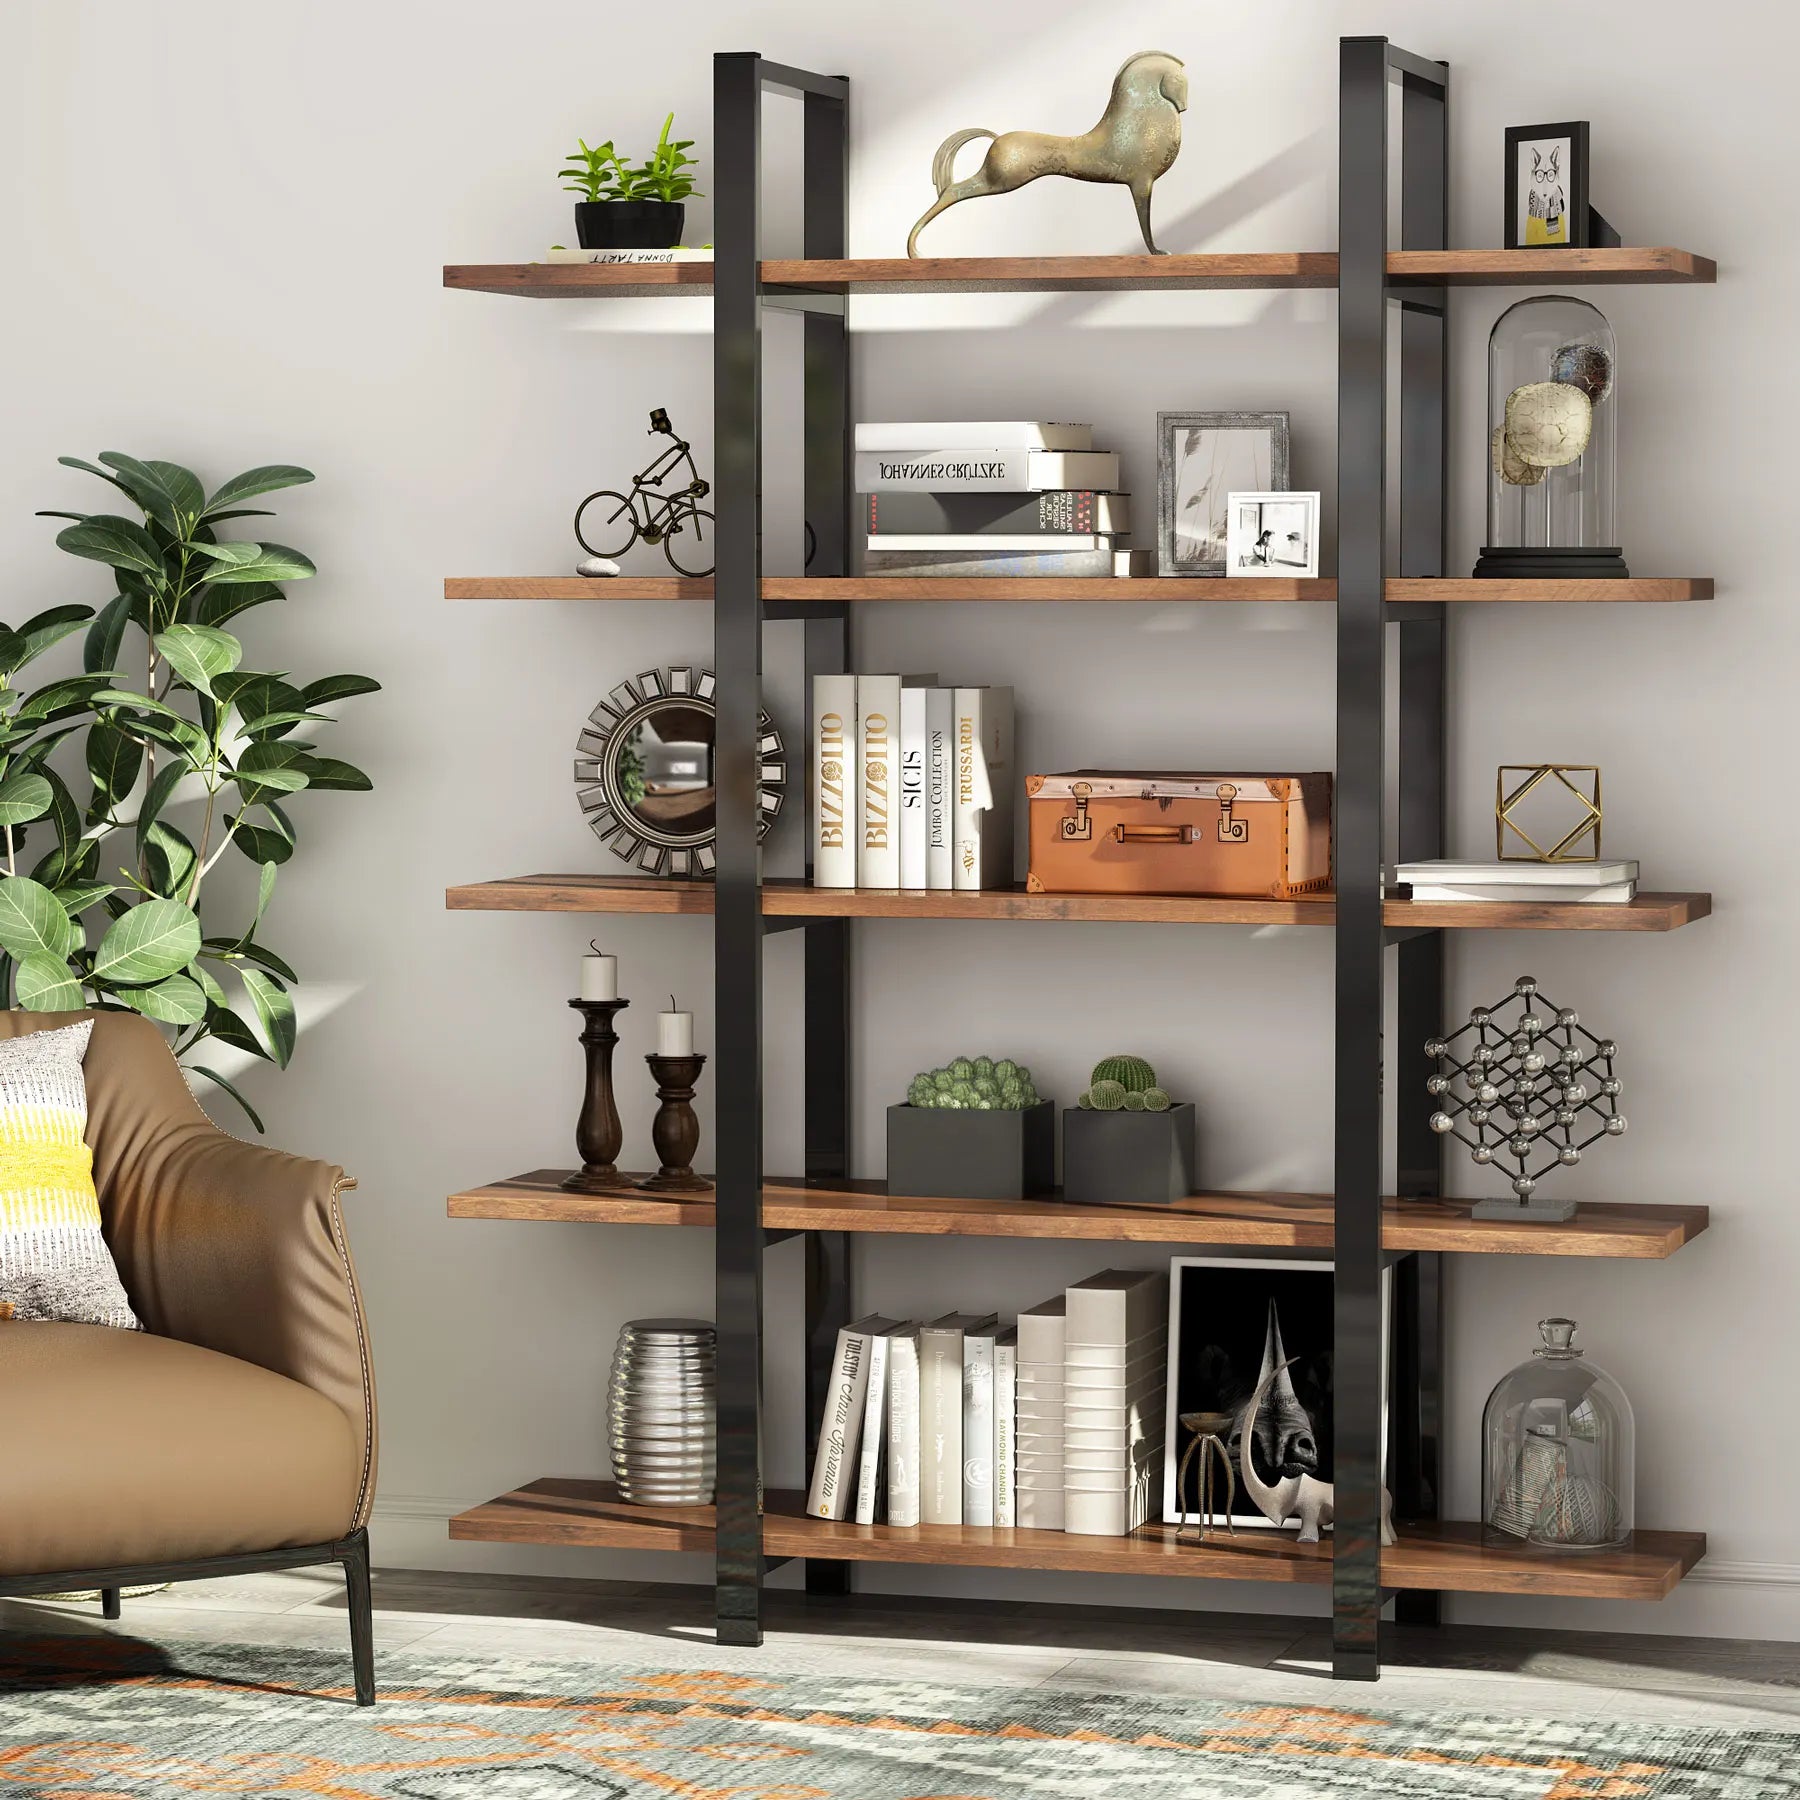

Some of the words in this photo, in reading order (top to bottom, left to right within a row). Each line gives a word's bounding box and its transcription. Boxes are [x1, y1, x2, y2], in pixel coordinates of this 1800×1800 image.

[589, 253, 633, 264] TARTT
[638, 253, 675, 263] DONNA
[902, 750, 922, 809] SICIS
[960, 716, 973, 805] TRUSSARDI
[930, 807, 944, 849] JUMBO
[841, 1338, 864, 1380] TOLSTOY
[999, 1352, 1007, 1366] THE
[836, 1383, 853, 1425] Anna
[891, 1369, 907, 1408] Sherlock
[891, 1410, 907, 1443] Holmes
[999, 1419, 1007, 1461] RAYMOND
[822, 1429, 845, 1498] Karenina
[999, 1463, 1007, 1506] CHANDLER
